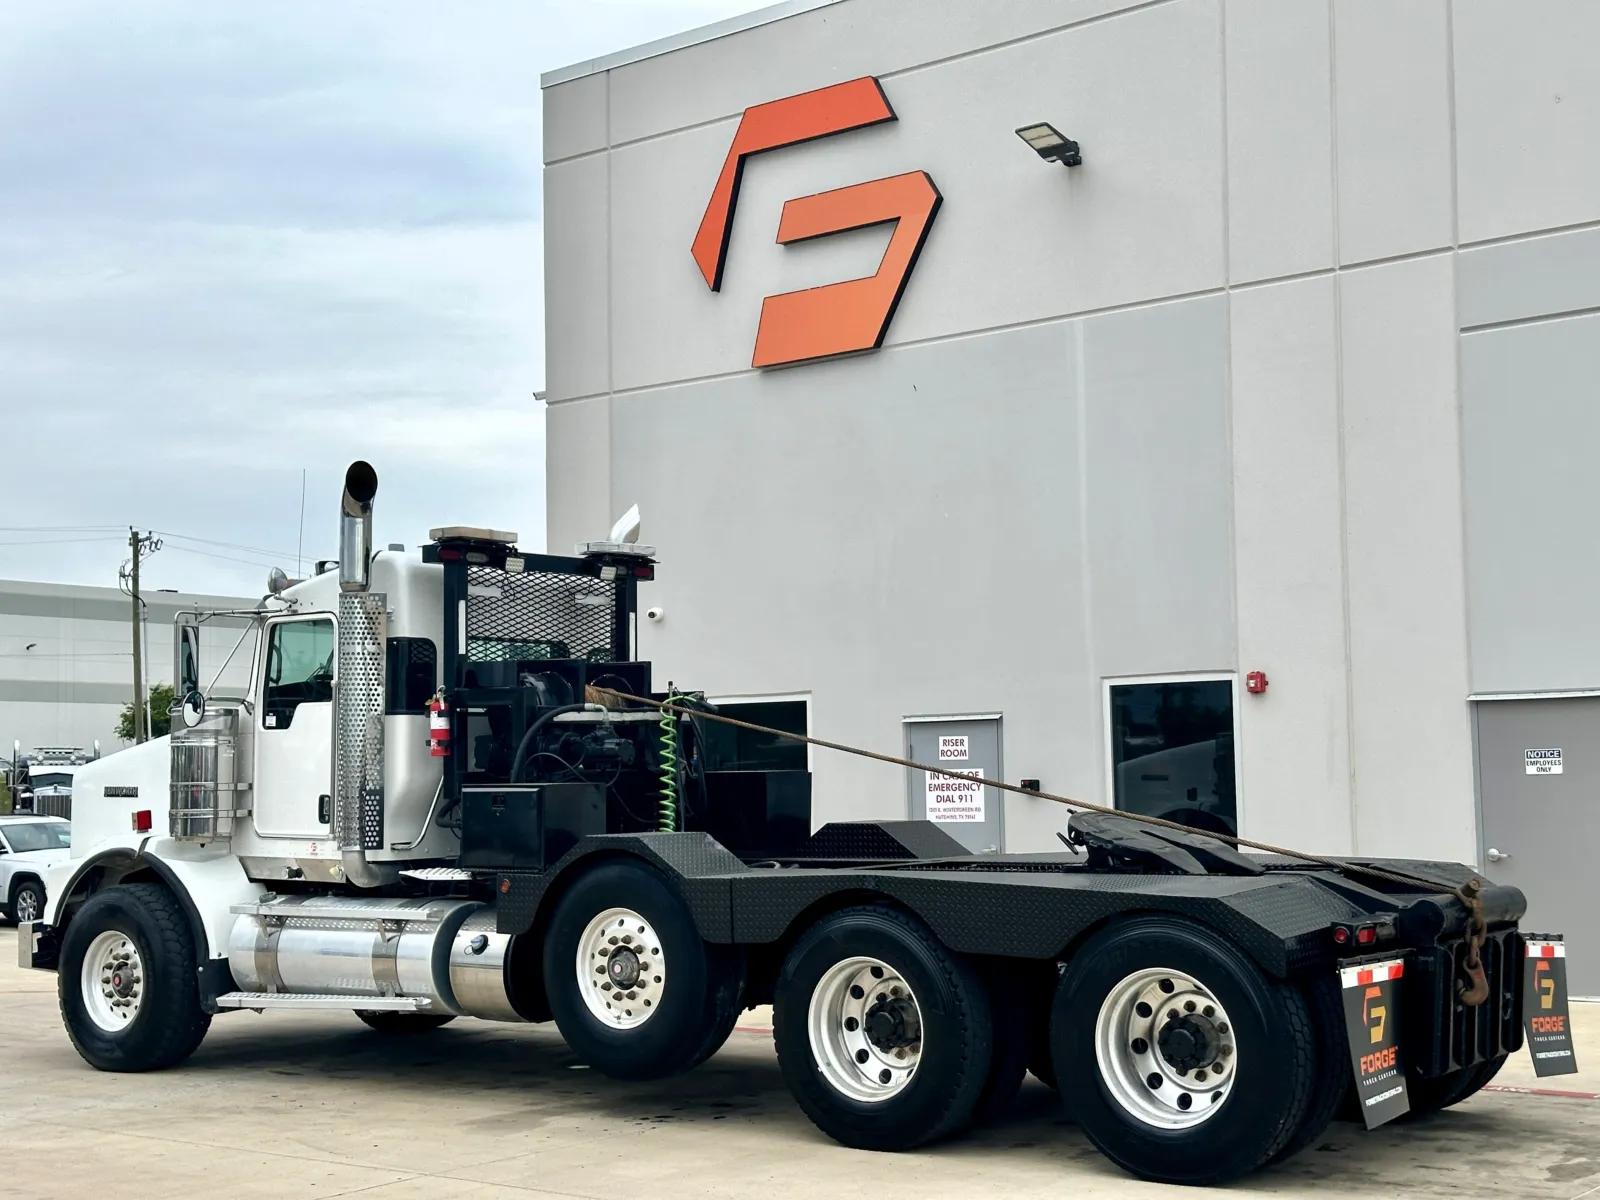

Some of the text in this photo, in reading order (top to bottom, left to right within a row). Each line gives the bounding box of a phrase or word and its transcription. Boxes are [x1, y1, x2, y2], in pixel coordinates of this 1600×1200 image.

[942, 738, 965, 747] RISER
[940, 749, 967, 758] ROOM
[1527, 750, 1560, 758] NOTICE
[930, 771, 940, 780] IN
[928, 782, 981, 792] EMERGENCY
[936, 794, 973, 804] DIAL 911
[1531, 1016, 1565, 1033] FORGE
[1360, 1046, 1397, 1076] FORGE
